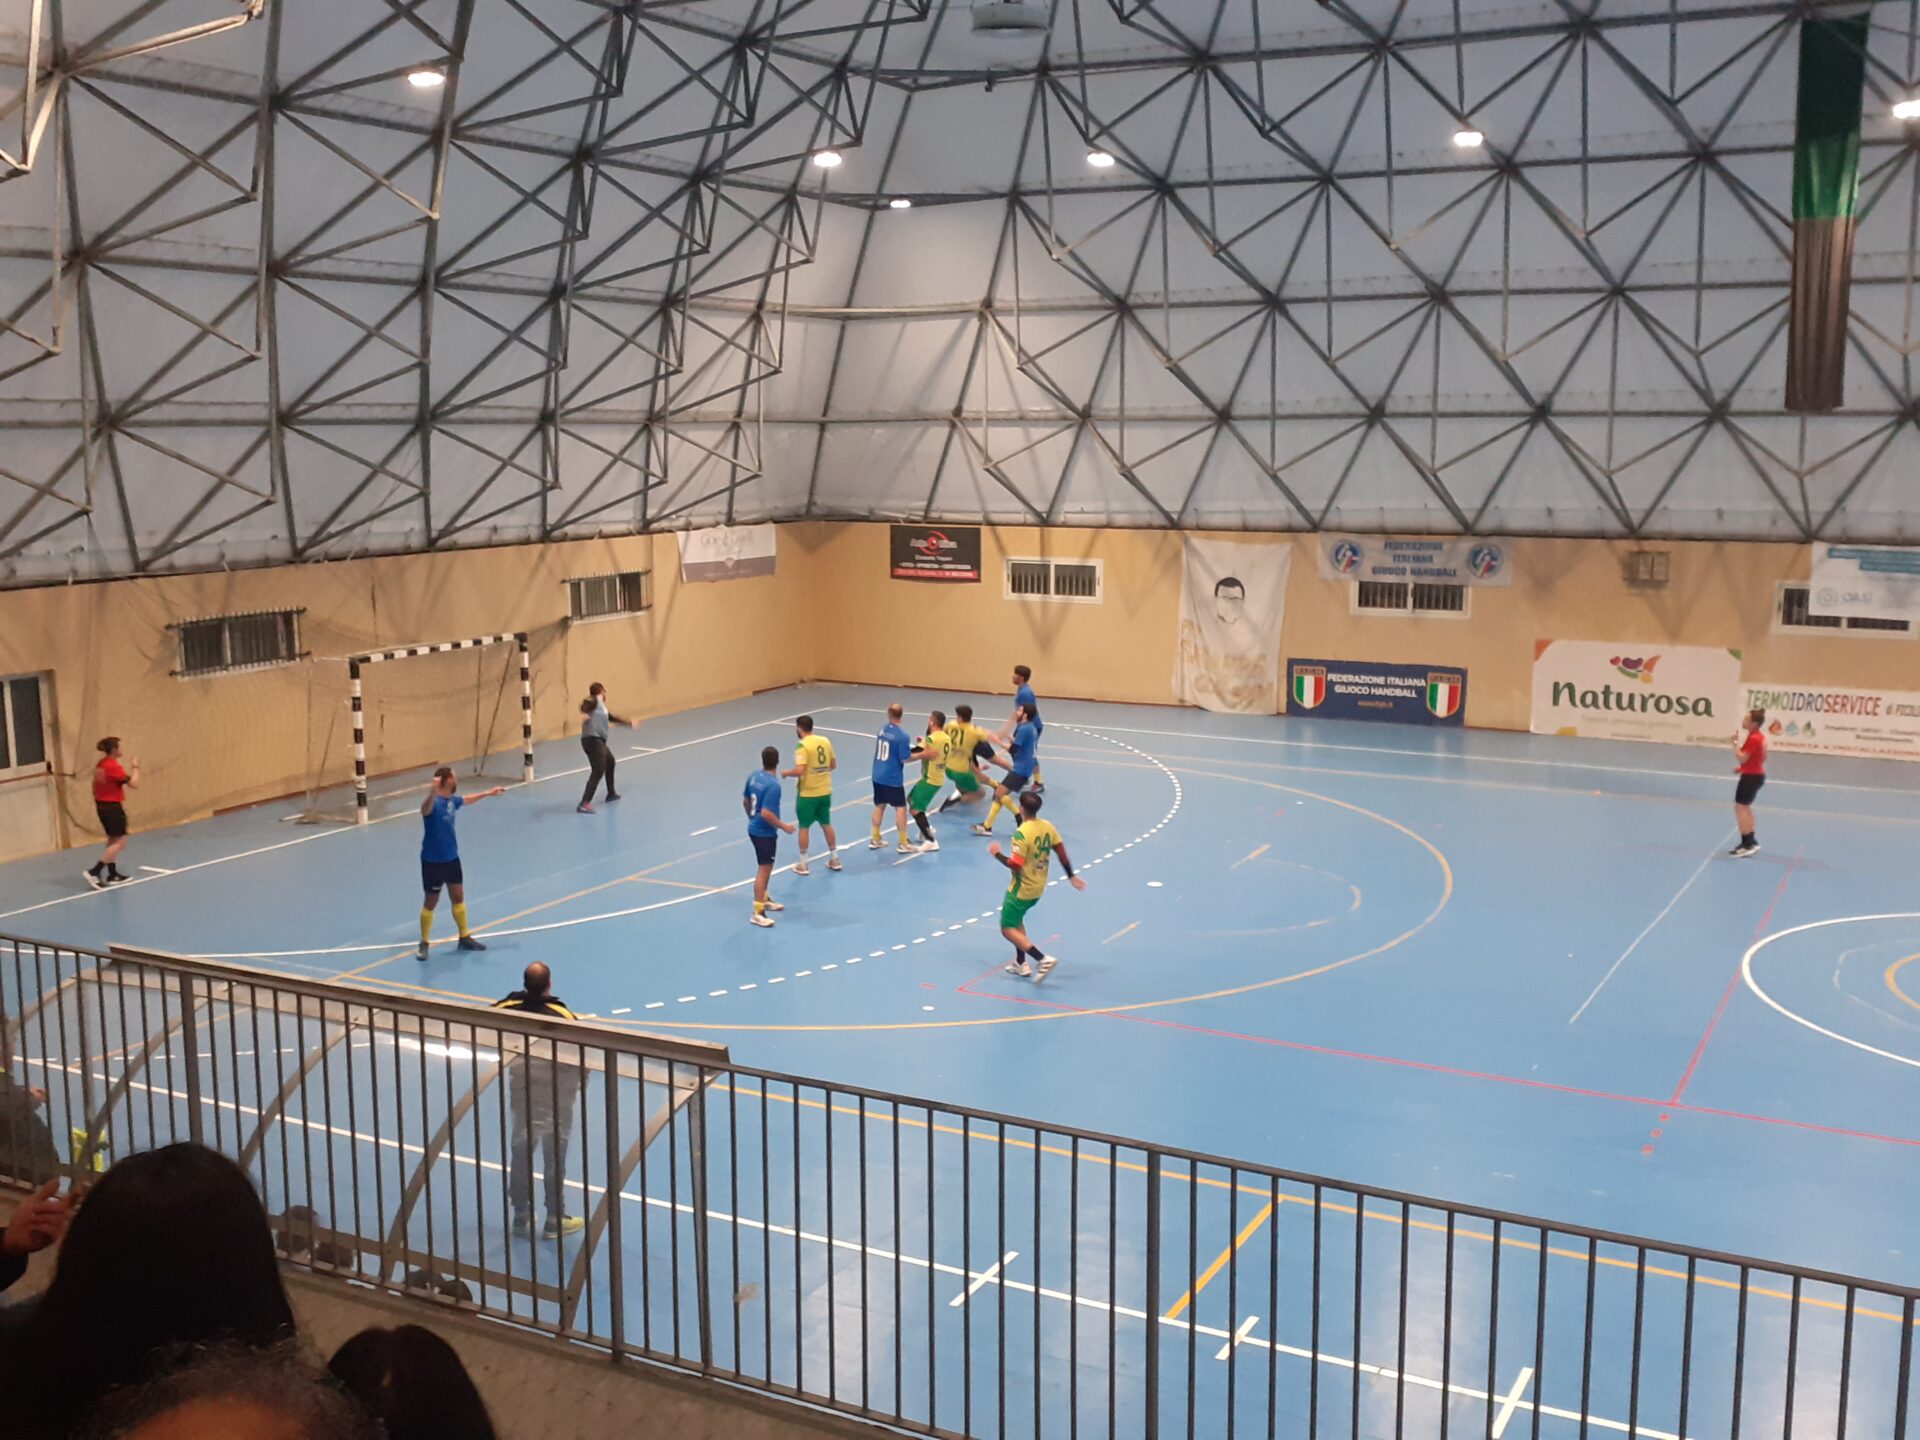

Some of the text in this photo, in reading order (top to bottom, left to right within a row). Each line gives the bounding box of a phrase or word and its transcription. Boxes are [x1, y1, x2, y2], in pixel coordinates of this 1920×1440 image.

[1410, 567, 1457, 577] HANDBALL
[1327, 673, 1386, 685] FEDERAZIONE
[1387, 676, 1427, 687] ITALIANA
[1334, 685, 1418, 698] GIUOCO HANDBALL
[1747, 689, 1882, 717] TERMOIDROSERVICE
[951, 728, 966, 747] 21
[816, 744, 827, 765] 8
[876, 739, 890, 762] 10
[943, 743, 950, 761] 9
[1034, 832, 1051, 859] 34
